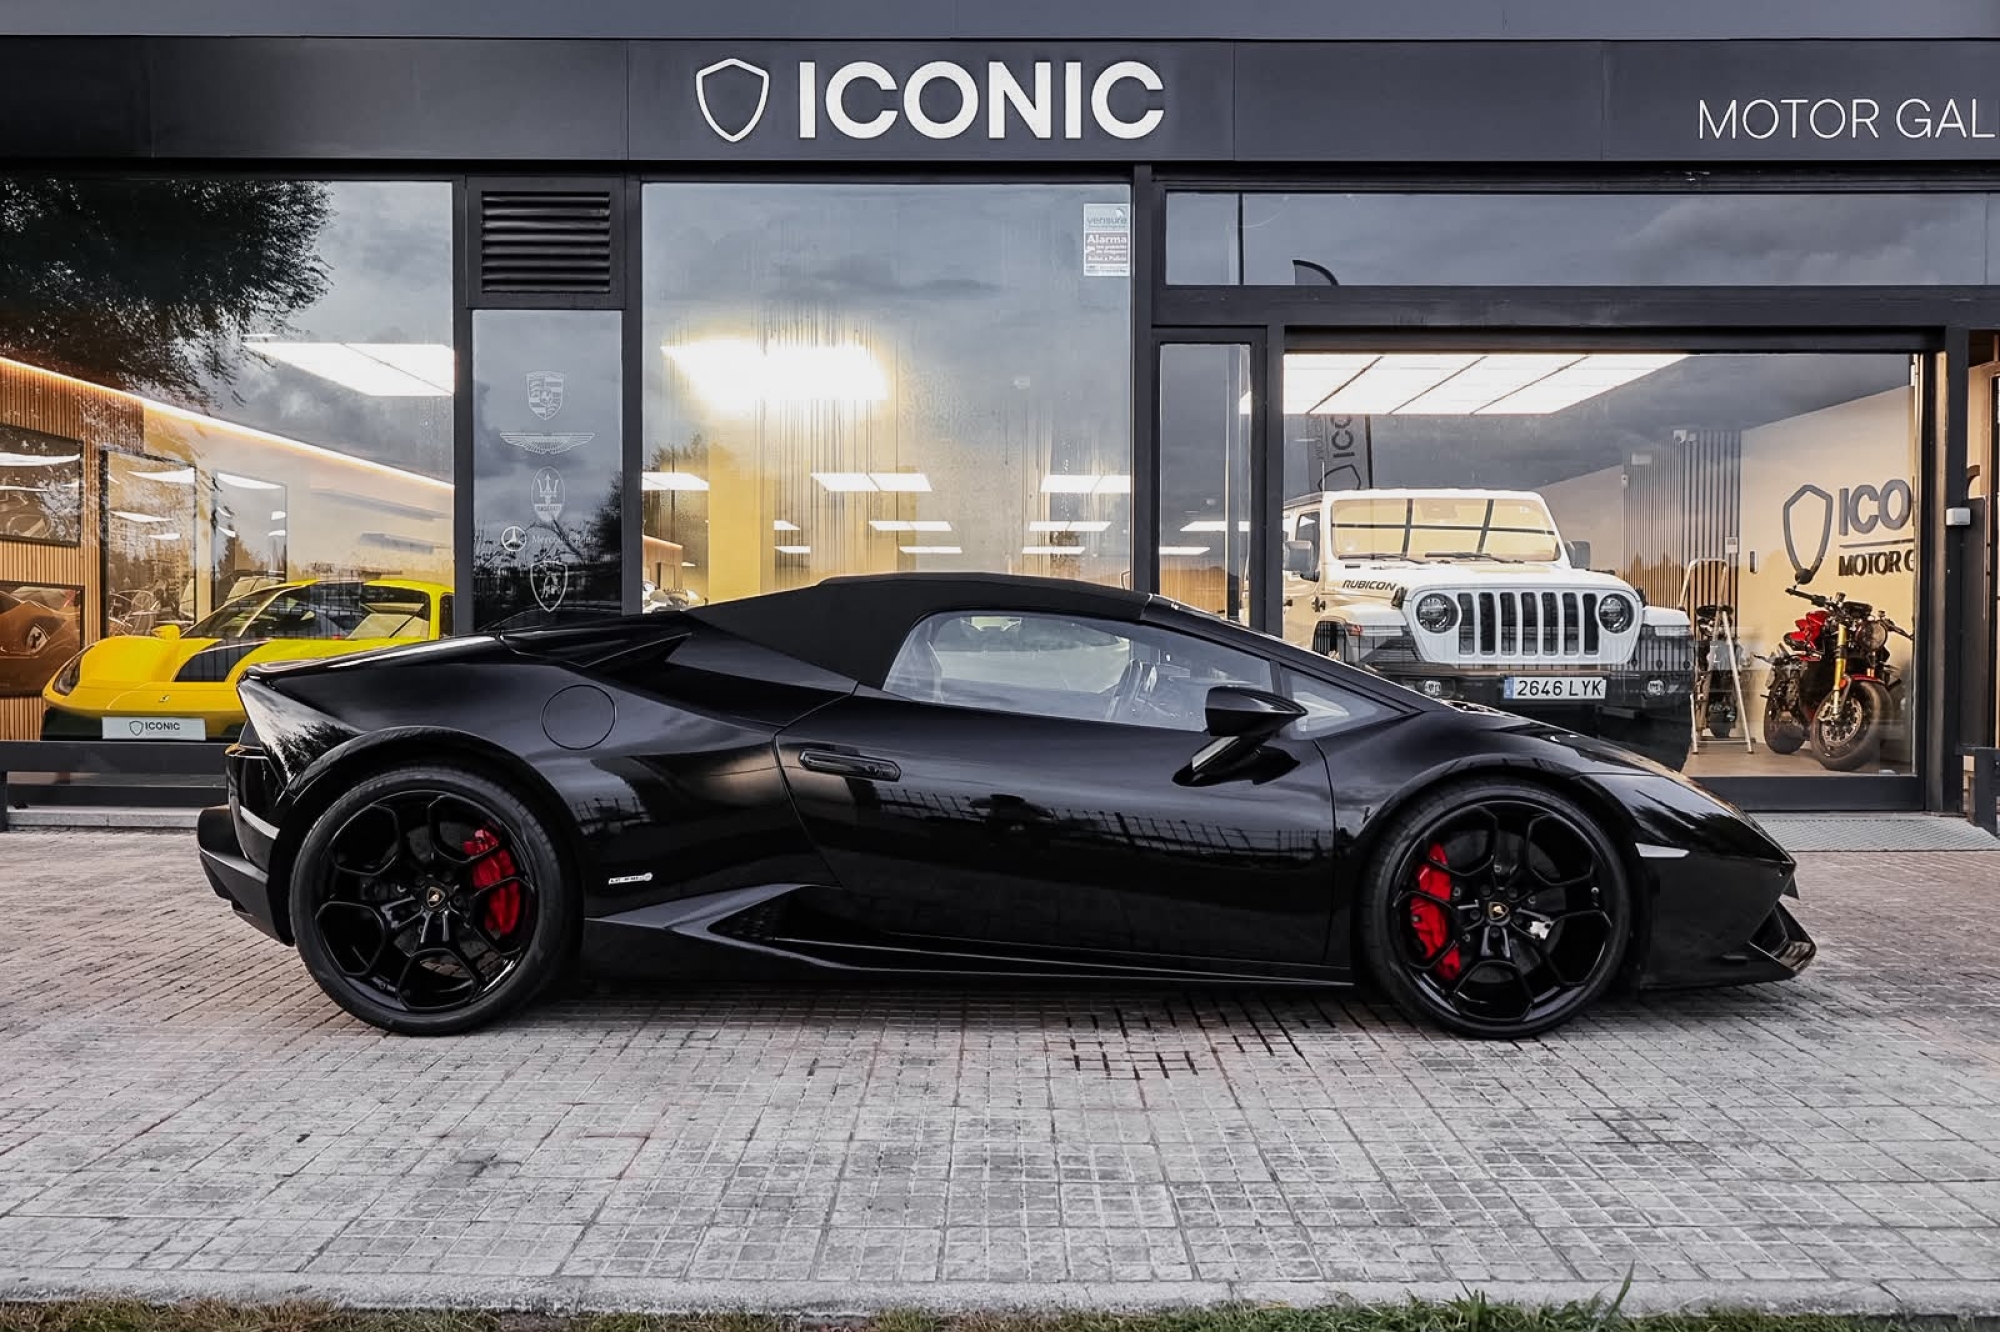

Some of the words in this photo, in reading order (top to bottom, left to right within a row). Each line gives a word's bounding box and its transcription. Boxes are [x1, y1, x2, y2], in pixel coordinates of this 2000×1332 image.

[799, 60, 1165, 140] ICONIC
[1699, 98, 1880, 140] MOTOR
[1895, 98, 1996, 139] GAL
[1087, 234, 1127, 244] Alarma
[1839, 479, 1914, 536] ICO
[1838, 550, 1901, 576] MOTOR
[1342, 579, 1397, 591] RUBICON
[1517, 680, 1563, 697] 2646
[1569, 680, 1602, 697] LYK
[145, 721, 180, 731] ICONIC
